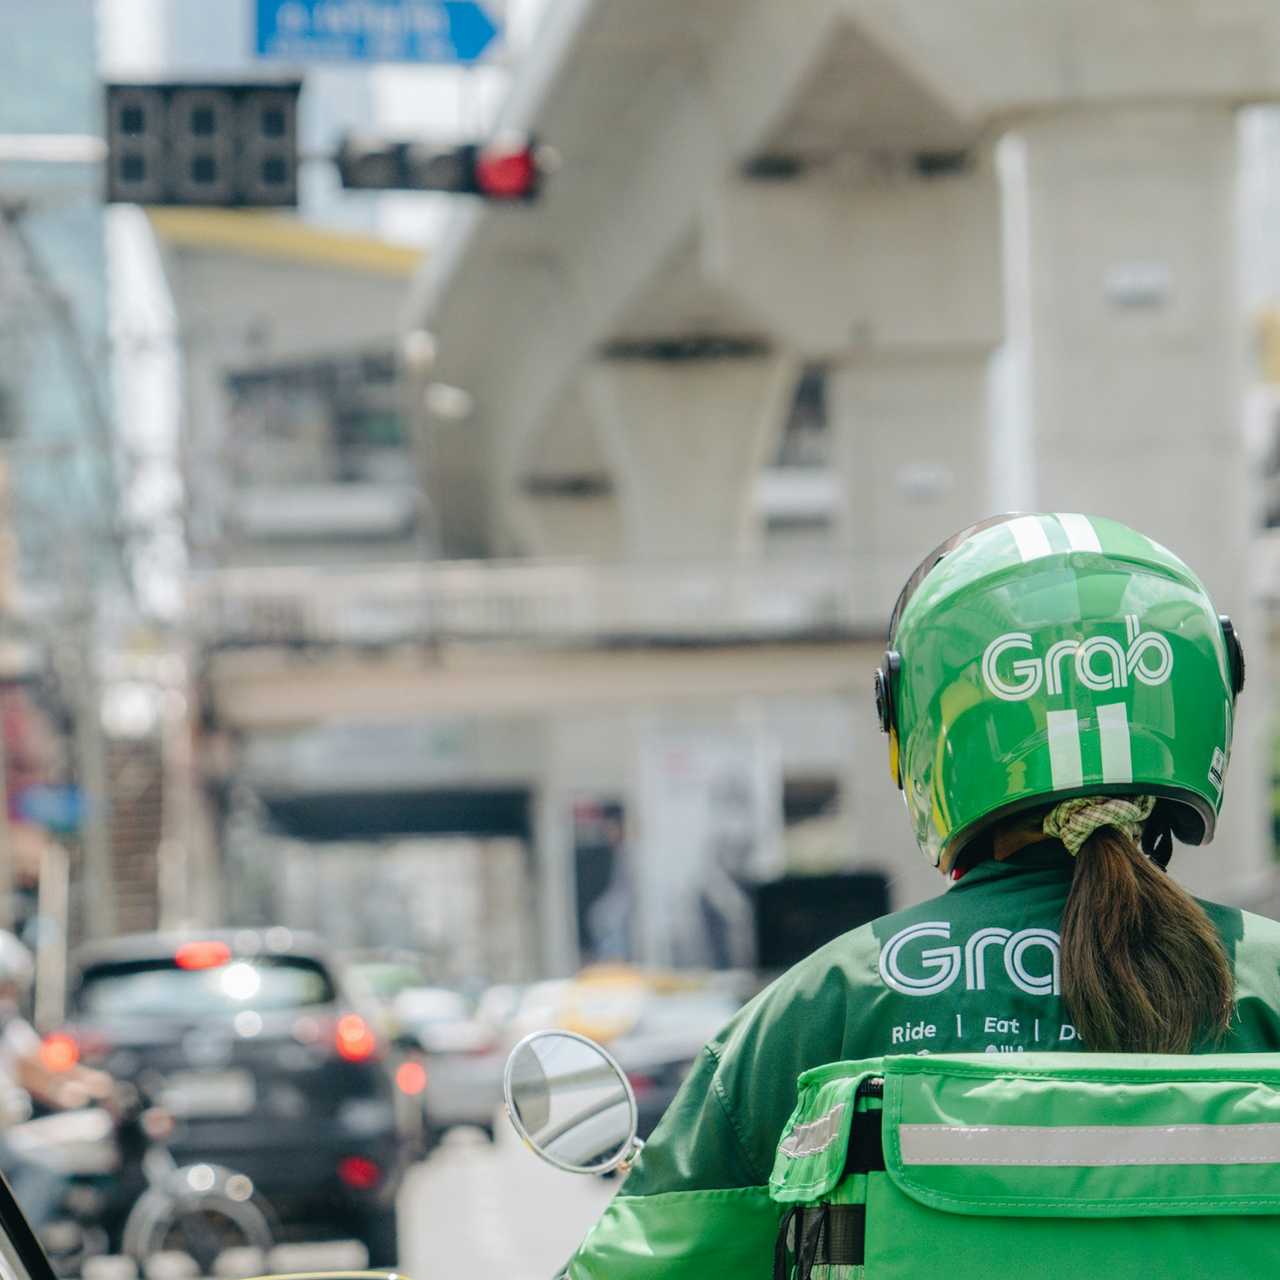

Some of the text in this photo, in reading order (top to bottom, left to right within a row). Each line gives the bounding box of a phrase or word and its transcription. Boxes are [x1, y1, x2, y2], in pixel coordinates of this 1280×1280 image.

[982, 614, 1174, 701] Grab
[879, 922, 1061, 996] Gra
[892, 1021, 936, 1044] Ride
[984, 1017, 1020, 1034] Eat
